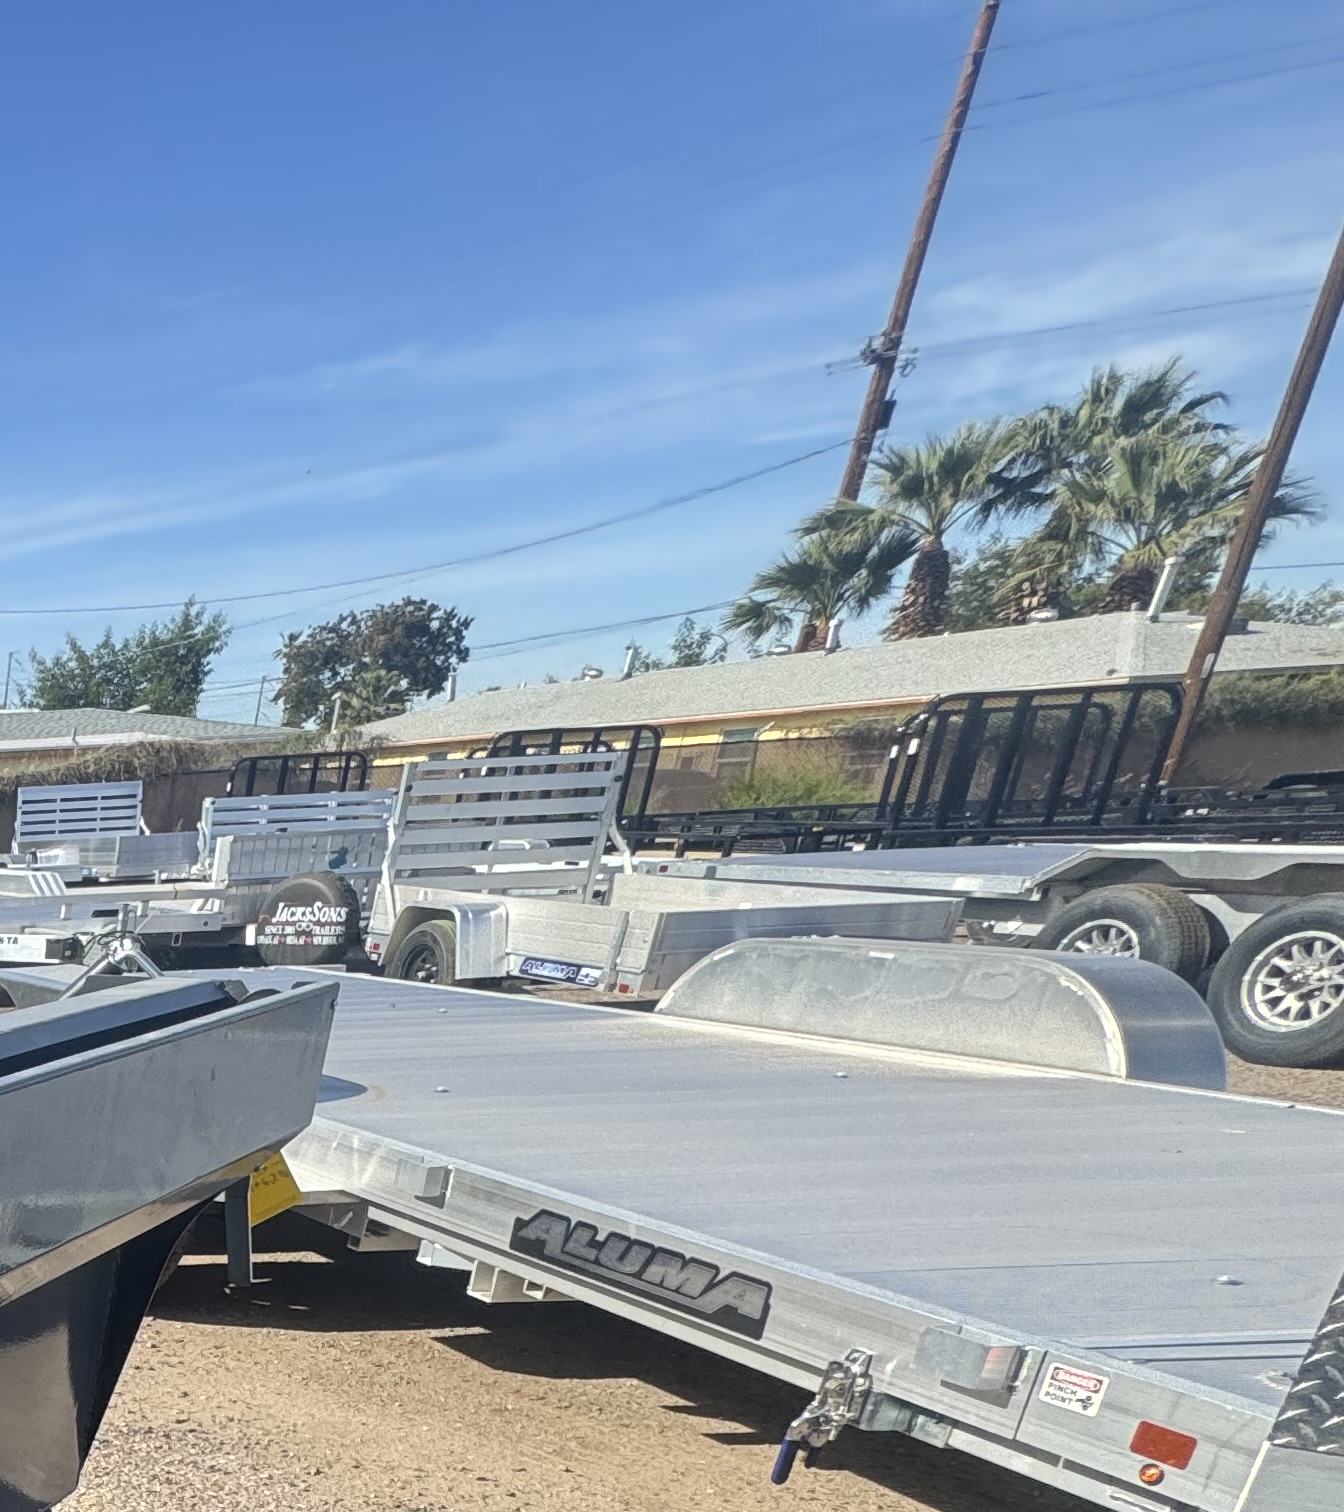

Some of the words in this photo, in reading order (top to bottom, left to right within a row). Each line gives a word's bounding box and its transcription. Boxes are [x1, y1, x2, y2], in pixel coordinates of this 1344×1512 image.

[517, 1213, 772, 1321] ALUMA
[1048, 1381, 1078, 1397] PINCH
[1044, 1390, 1074, 1406] POINT
